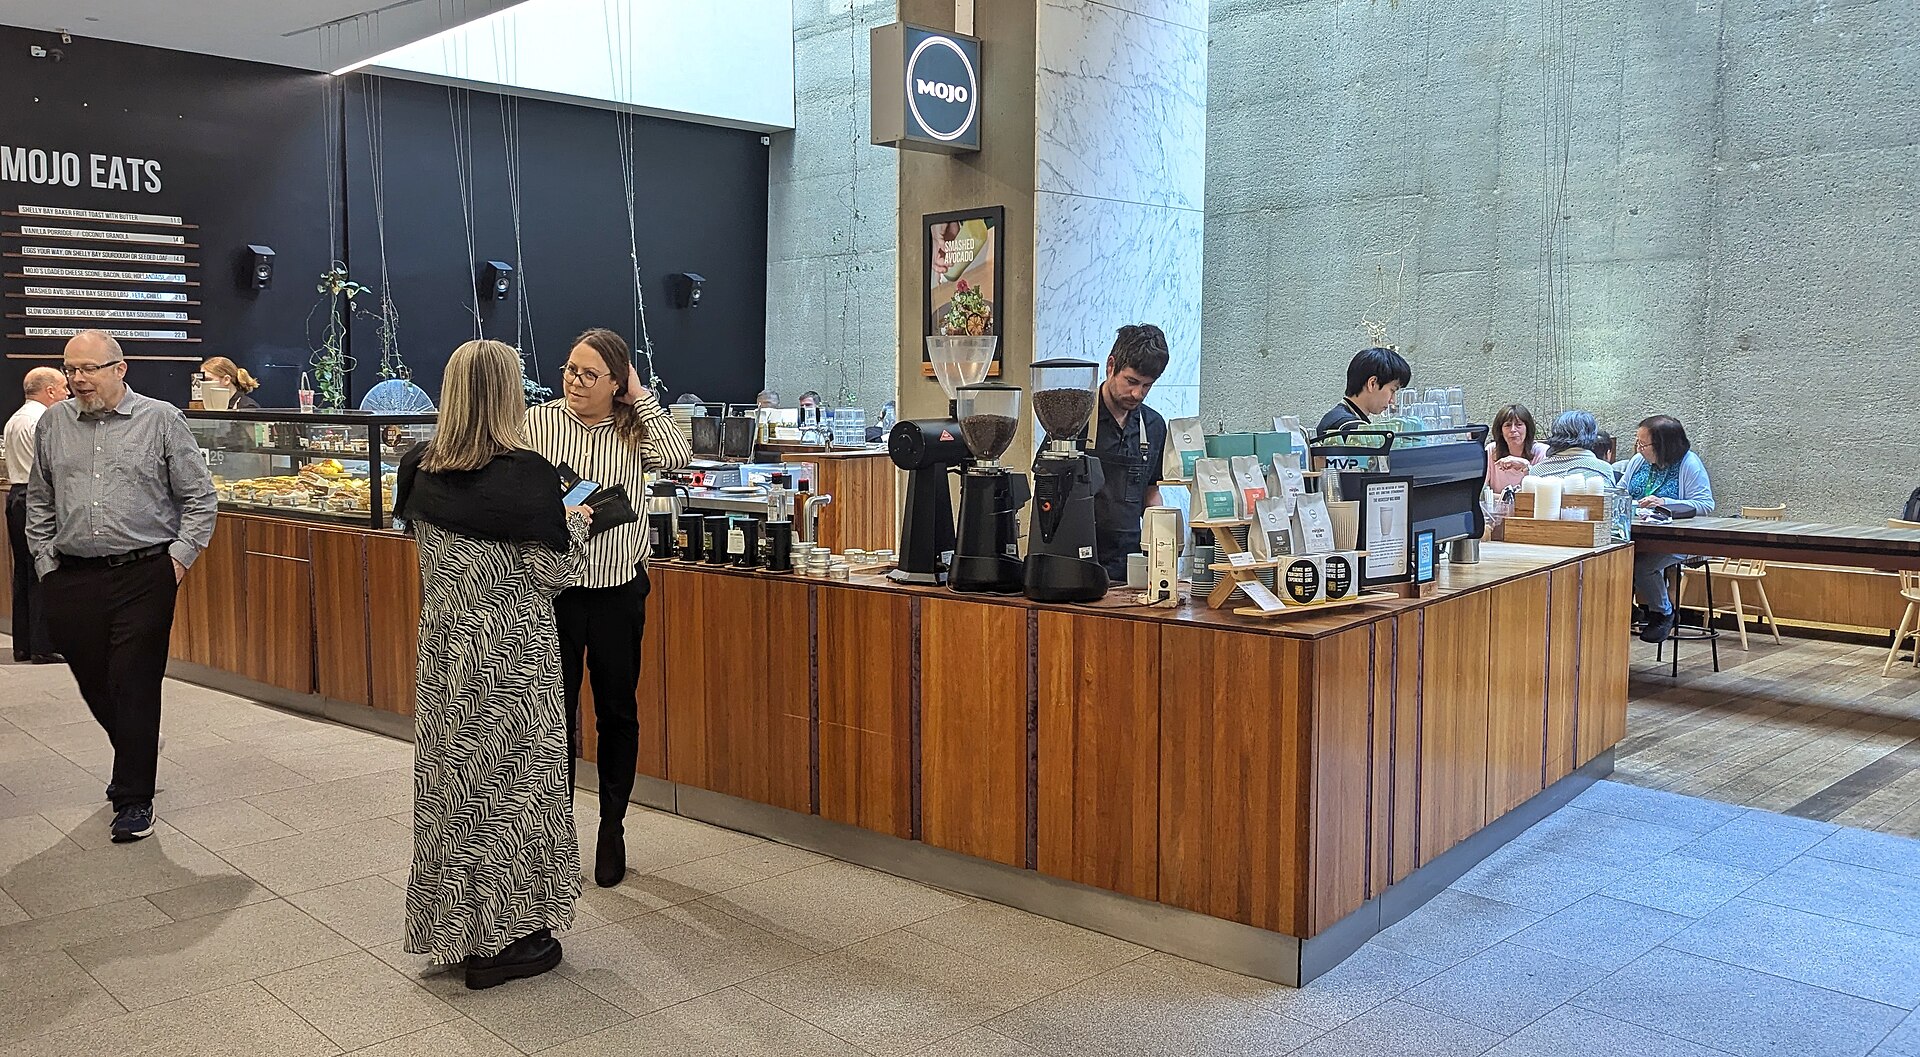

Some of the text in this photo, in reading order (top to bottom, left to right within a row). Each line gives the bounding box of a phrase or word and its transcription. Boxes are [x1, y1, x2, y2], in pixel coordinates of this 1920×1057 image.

[916, 78, 968, 103] MOJO
[1, 145, 162, 194] MOJO EATS
[944, 238, 974, 252] SMASHED
[944, 251, 974, 264] AVOCADO
[1326, 458, 1358, 470] MVP
